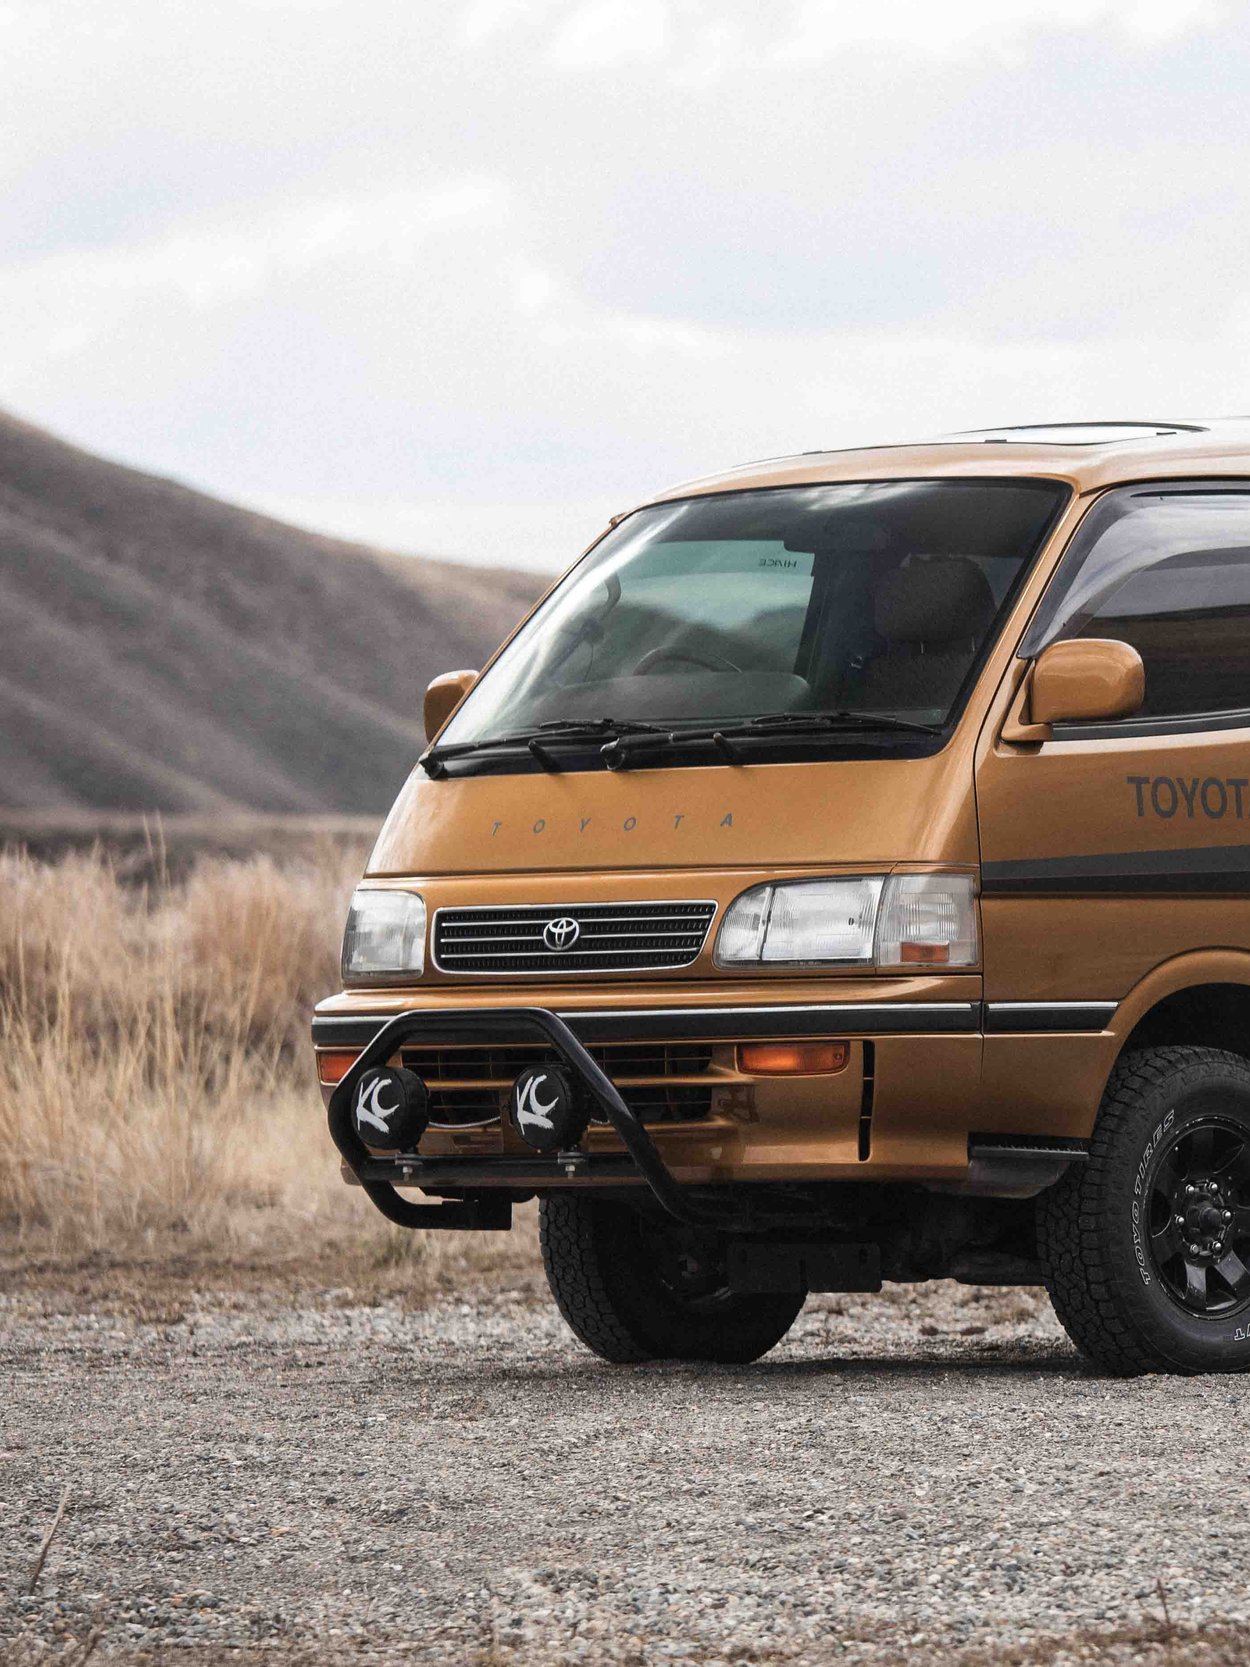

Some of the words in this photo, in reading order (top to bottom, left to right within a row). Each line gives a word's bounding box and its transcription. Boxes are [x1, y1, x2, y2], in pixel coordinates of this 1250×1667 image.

[491, 813, 734, 836] TOYOTA
[356, 1076, 399, 1133] KC
[517, 1074, 559, 1136] KC
[1134, 1109, 1175, 1196] TIRES
[1132, 1200, 1151, 1285] TOYO
